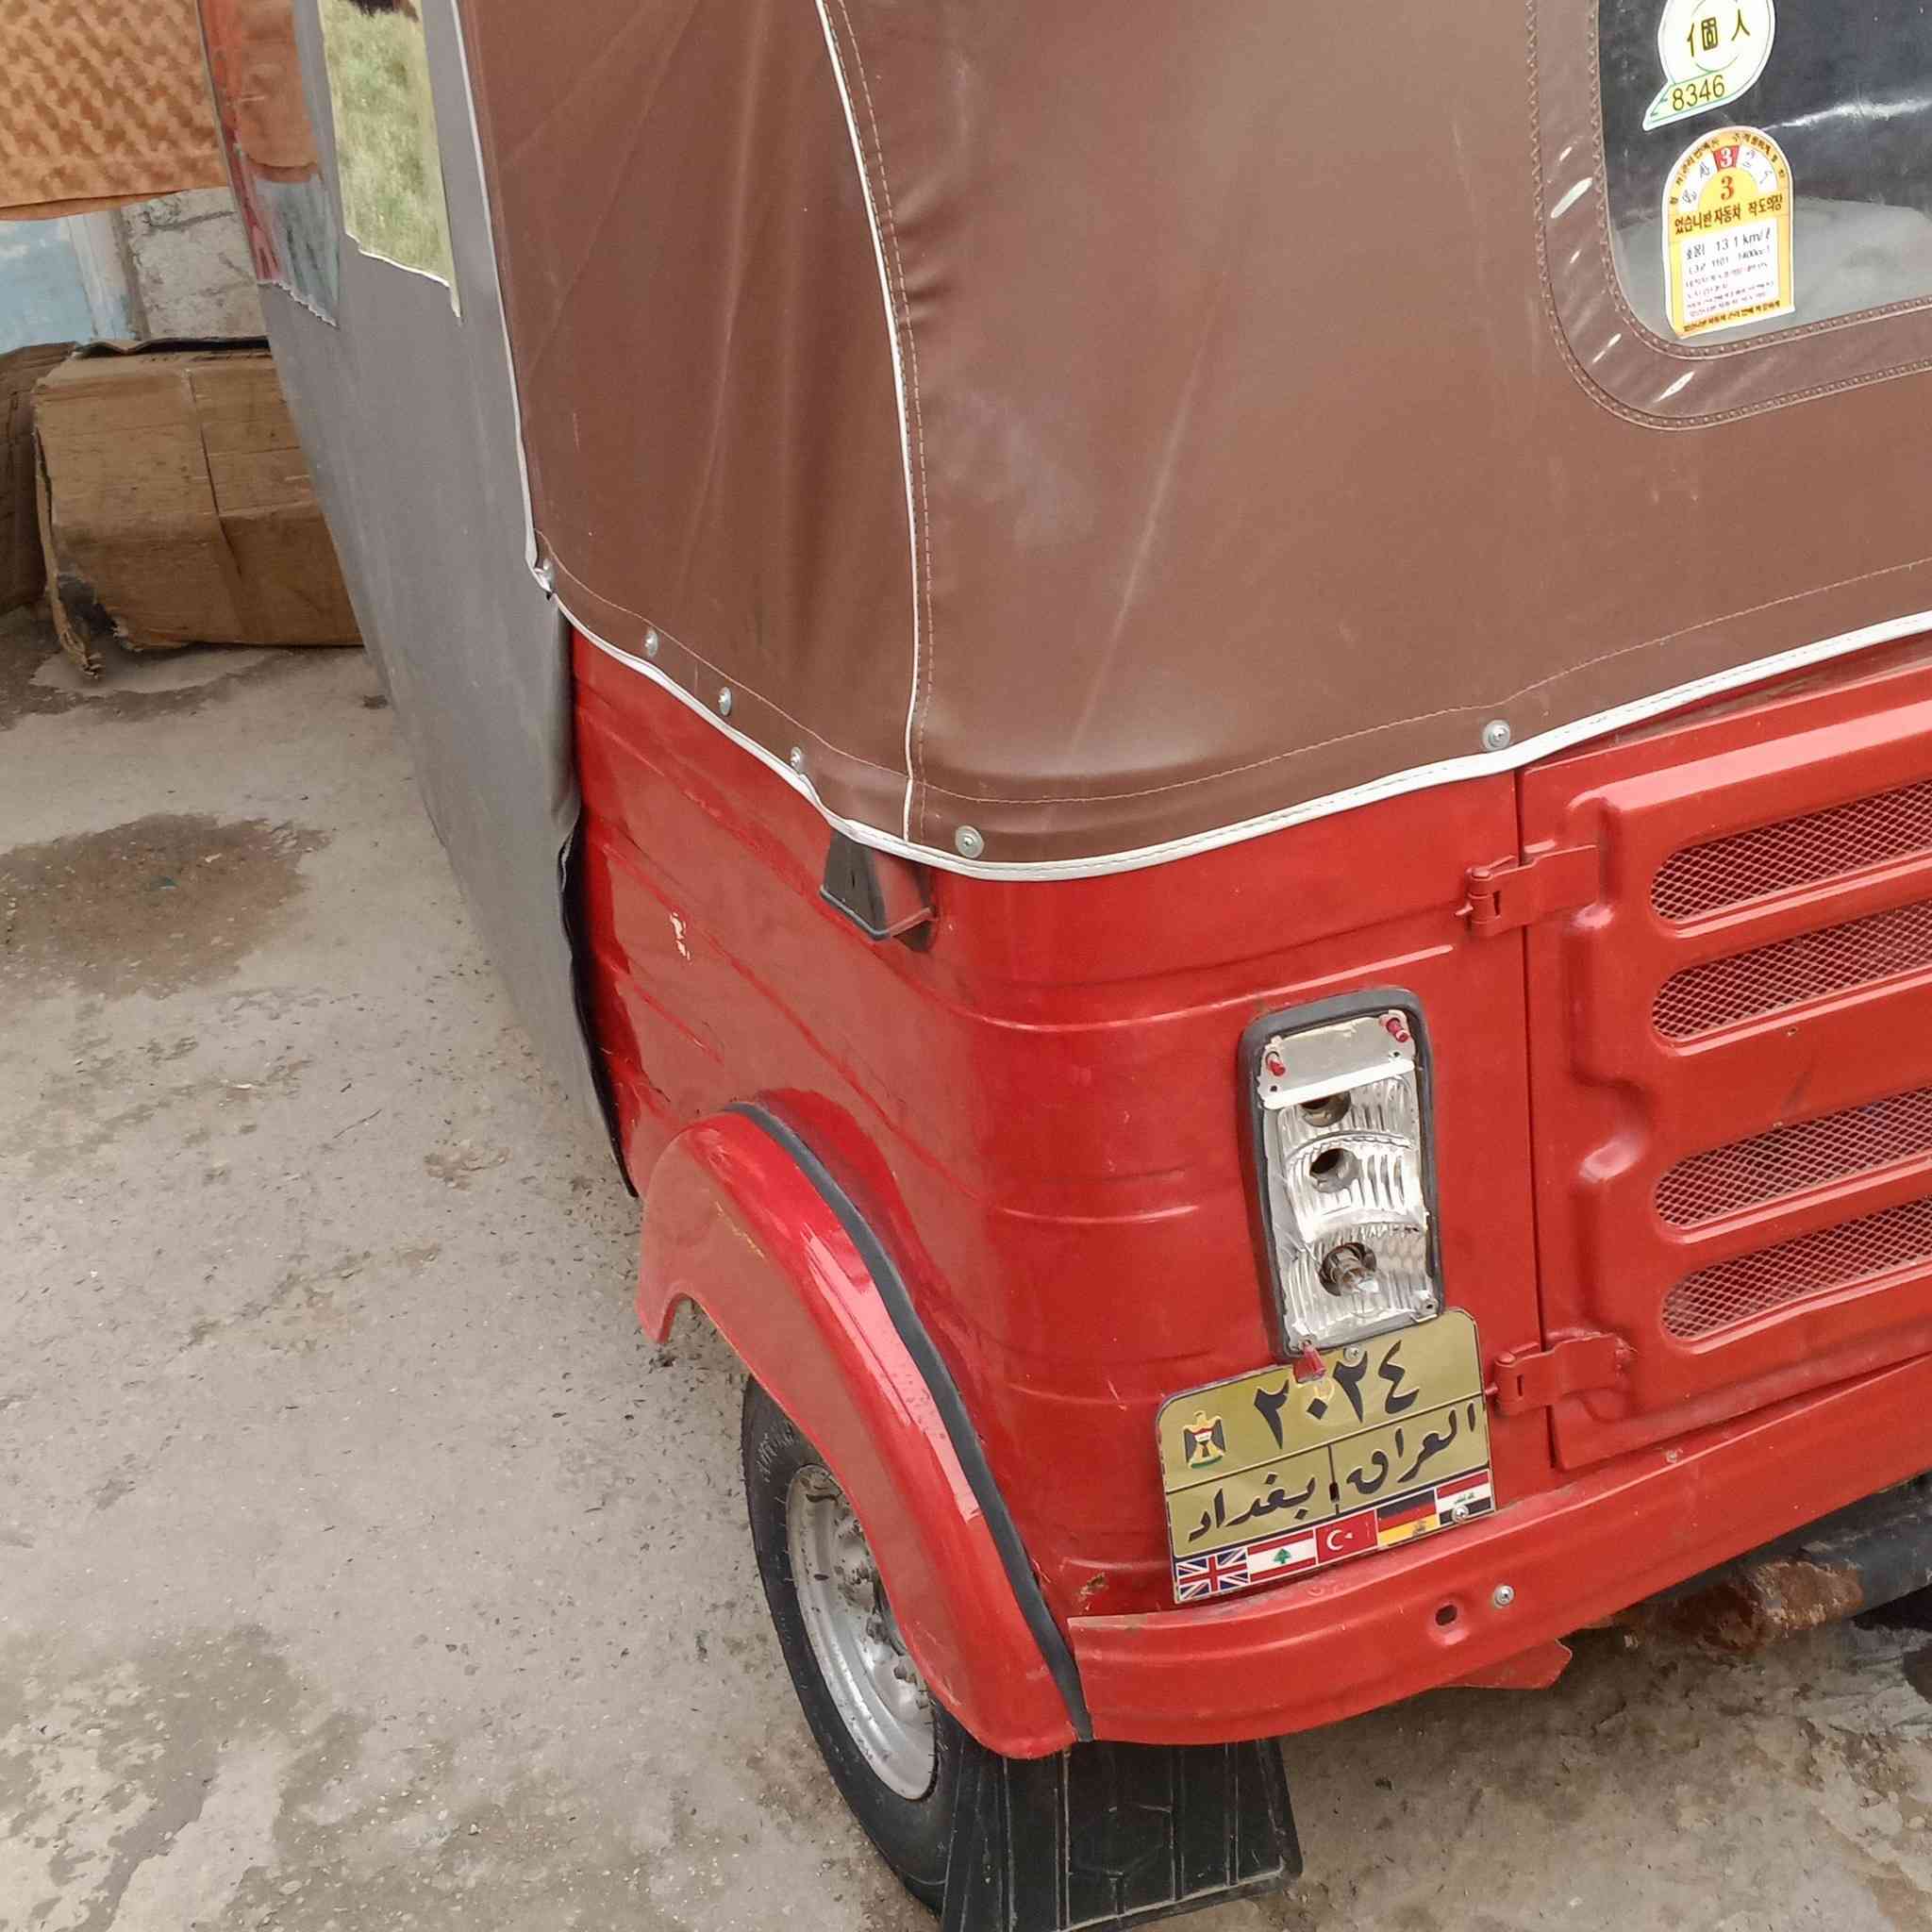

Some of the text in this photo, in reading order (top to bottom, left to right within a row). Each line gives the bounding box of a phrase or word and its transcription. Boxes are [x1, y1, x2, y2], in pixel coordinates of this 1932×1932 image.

[1687, 8, 1751, 58] 個人
[1672, 74, 1725, 111] 8346
[1720, 146, 1733, 168] 3
[1720, 175, 1735, 200] 3
[1254, 1340, 1420, 1450] ٢٠٢٤
[1189, 1472, 1316, 1542] بغداد
